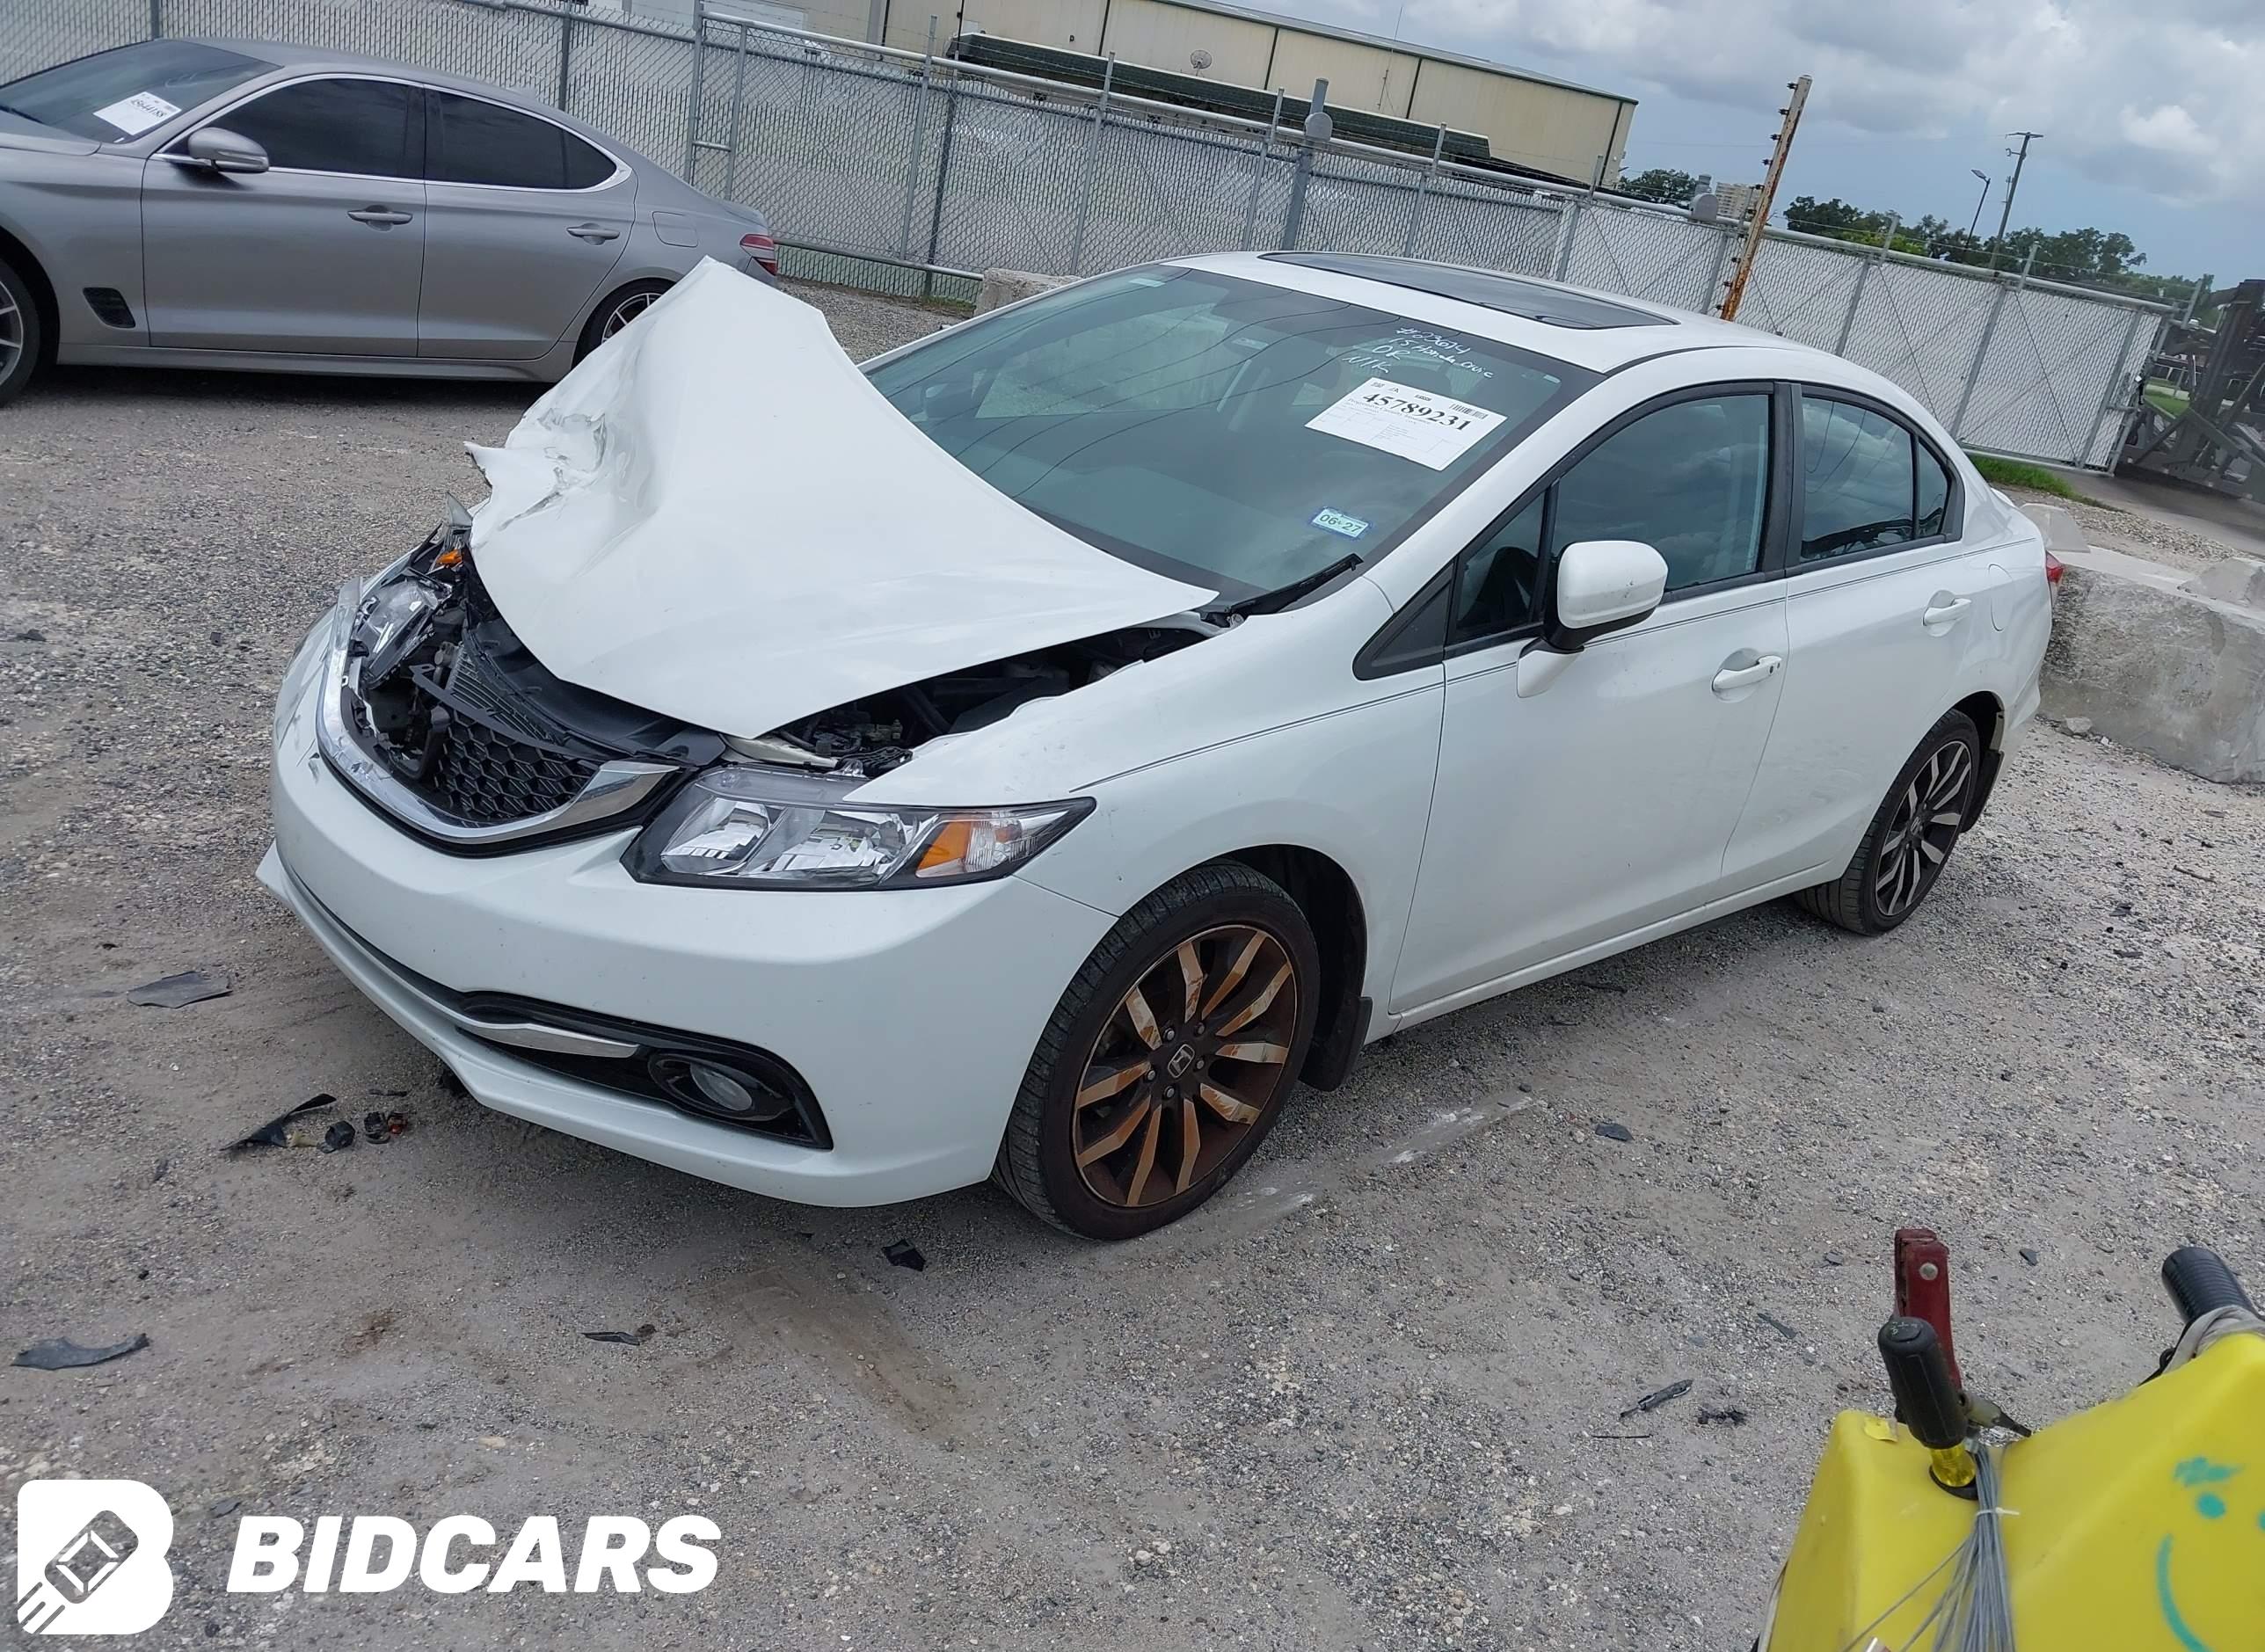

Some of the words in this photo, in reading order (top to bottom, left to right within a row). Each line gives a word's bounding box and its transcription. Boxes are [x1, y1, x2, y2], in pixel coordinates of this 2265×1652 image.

[1363, 393, 1472, 431] 45789231
[1320, 514, 1339, 525] 06
[1342, 521, 1363, 533] 27
